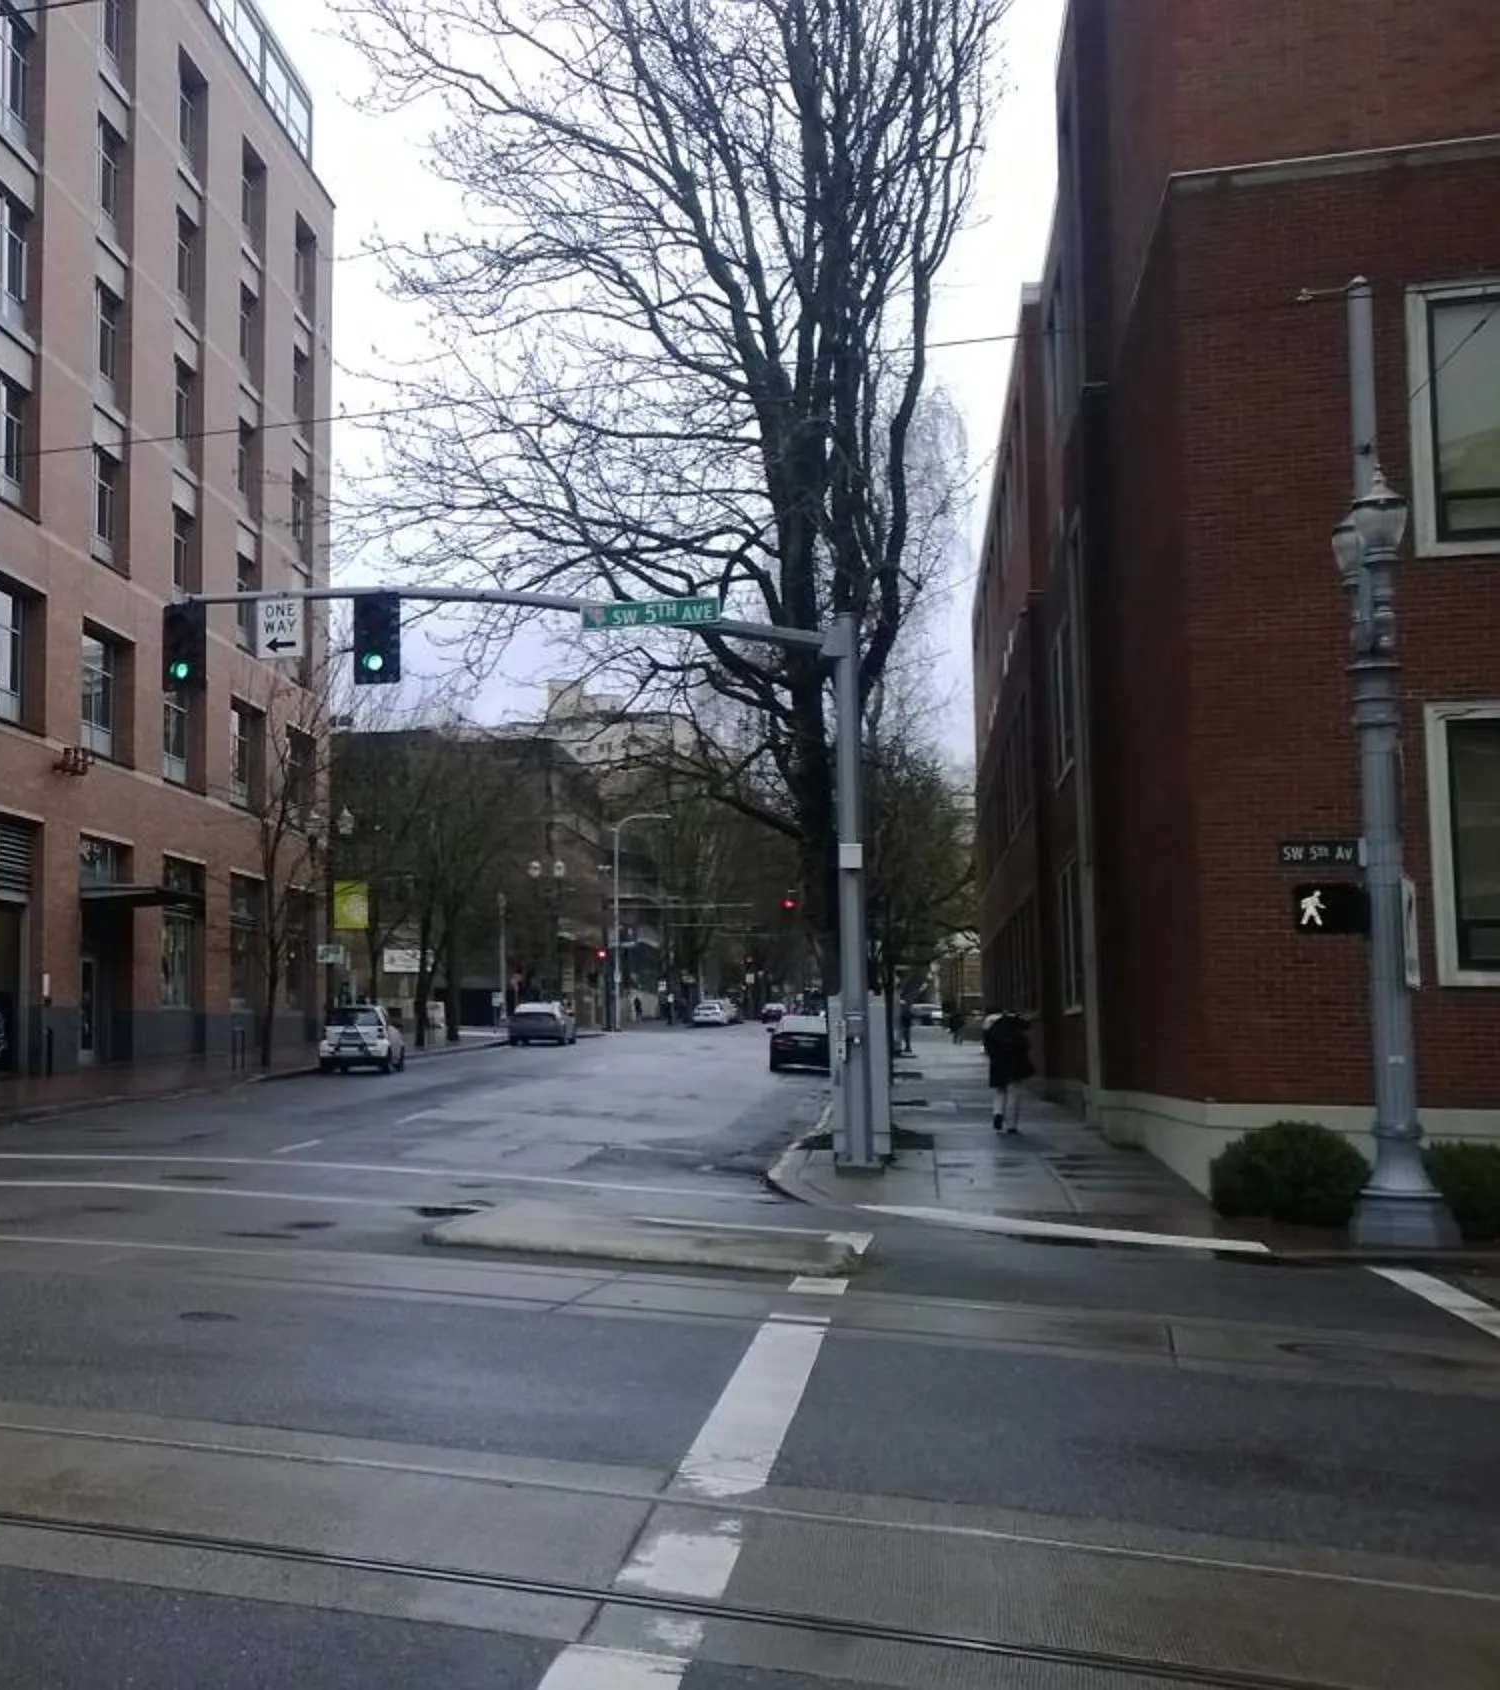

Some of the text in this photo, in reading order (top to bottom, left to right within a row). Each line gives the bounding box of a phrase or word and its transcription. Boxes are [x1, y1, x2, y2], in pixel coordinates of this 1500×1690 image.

[265, 602, 296, 618] ONE
[611, 603, 714, 625] SW 5TH AVE
[263, 618, 298, 634] WAY
[1283, 845, 1354, 861] SW 5th Av
